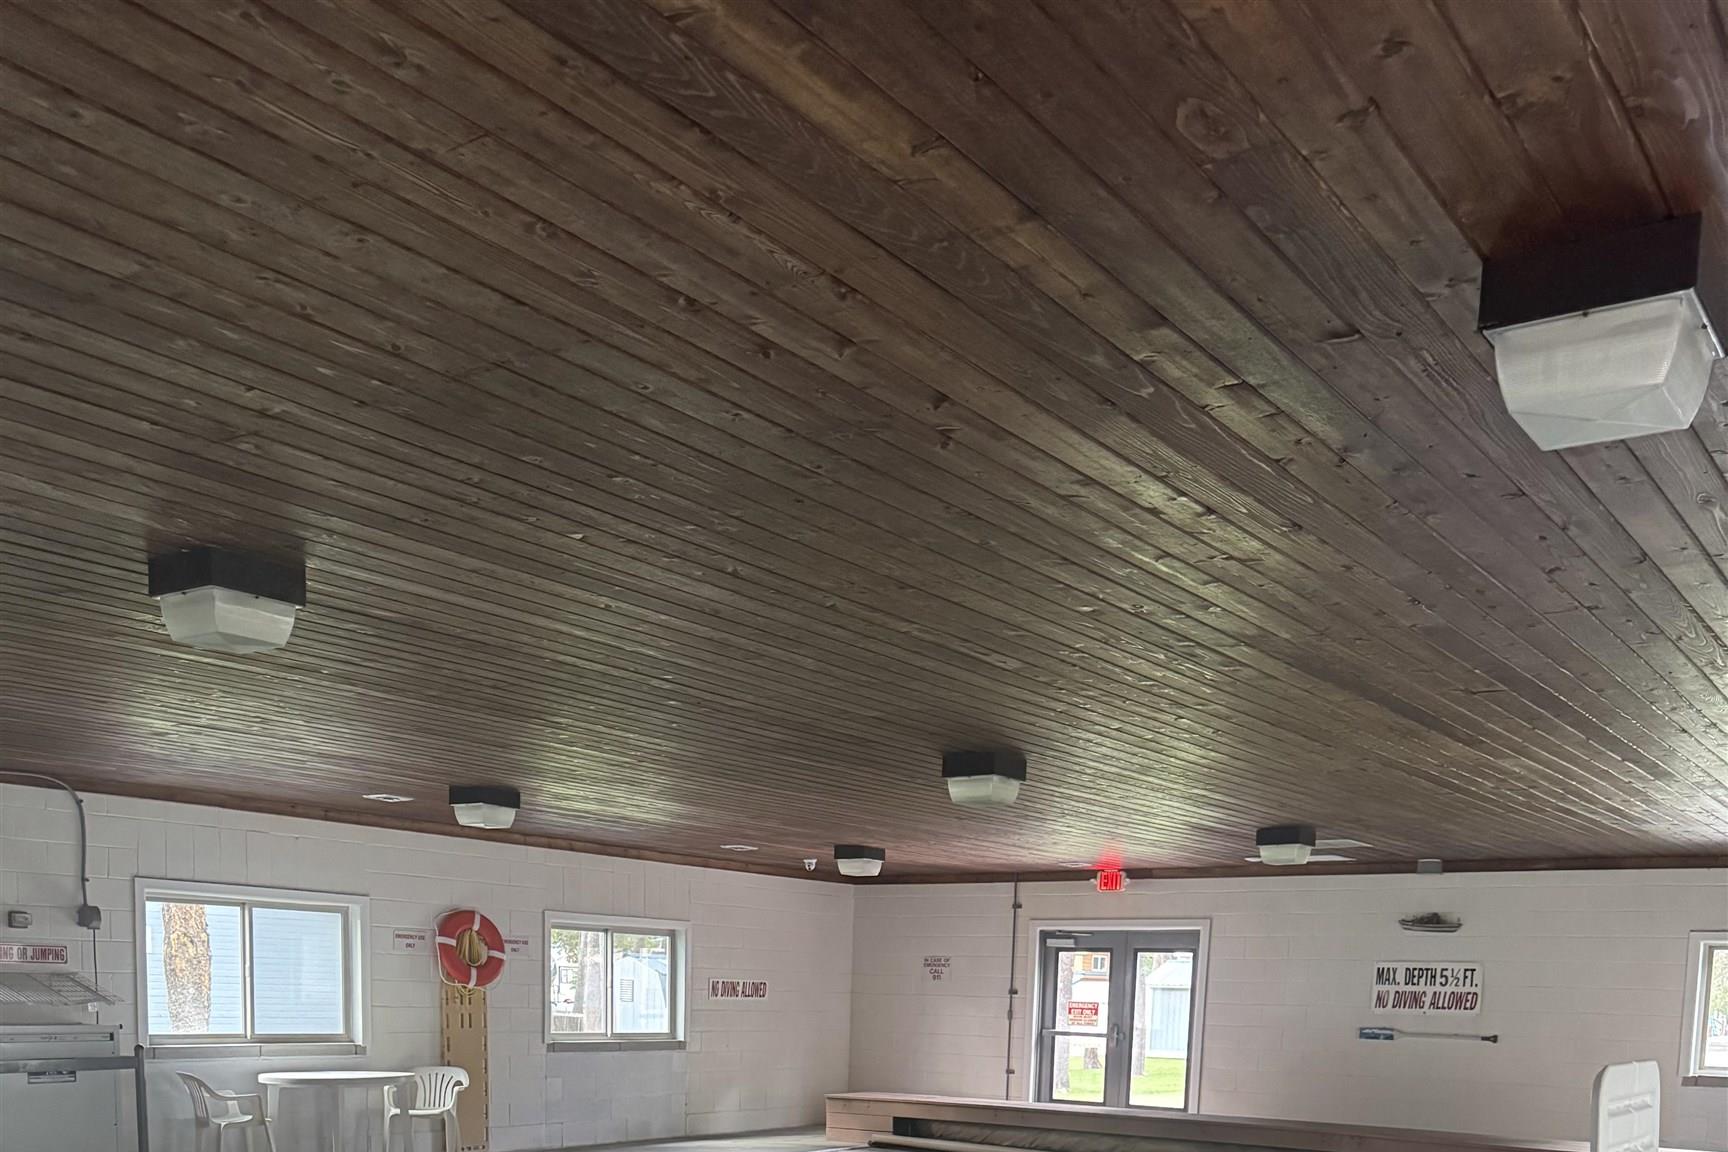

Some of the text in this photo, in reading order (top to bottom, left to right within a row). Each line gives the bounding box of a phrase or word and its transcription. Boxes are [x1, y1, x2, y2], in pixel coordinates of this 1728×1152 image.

[1101, 871, 1121, 890] EXIT
[17, 947, 28, 960] OR
[31, 947, 65, 961] JUMPING
[1375, 966, 1400, 986] MAX.
[1404, 967, 1437, 987] DEPTH
[1462, 968, 1478, 988] FT.
[711, 980, 767, 998] NO DIVING ALLOWED
[1374, 989, 1478, 1011] NO DIVING ALLOWED
